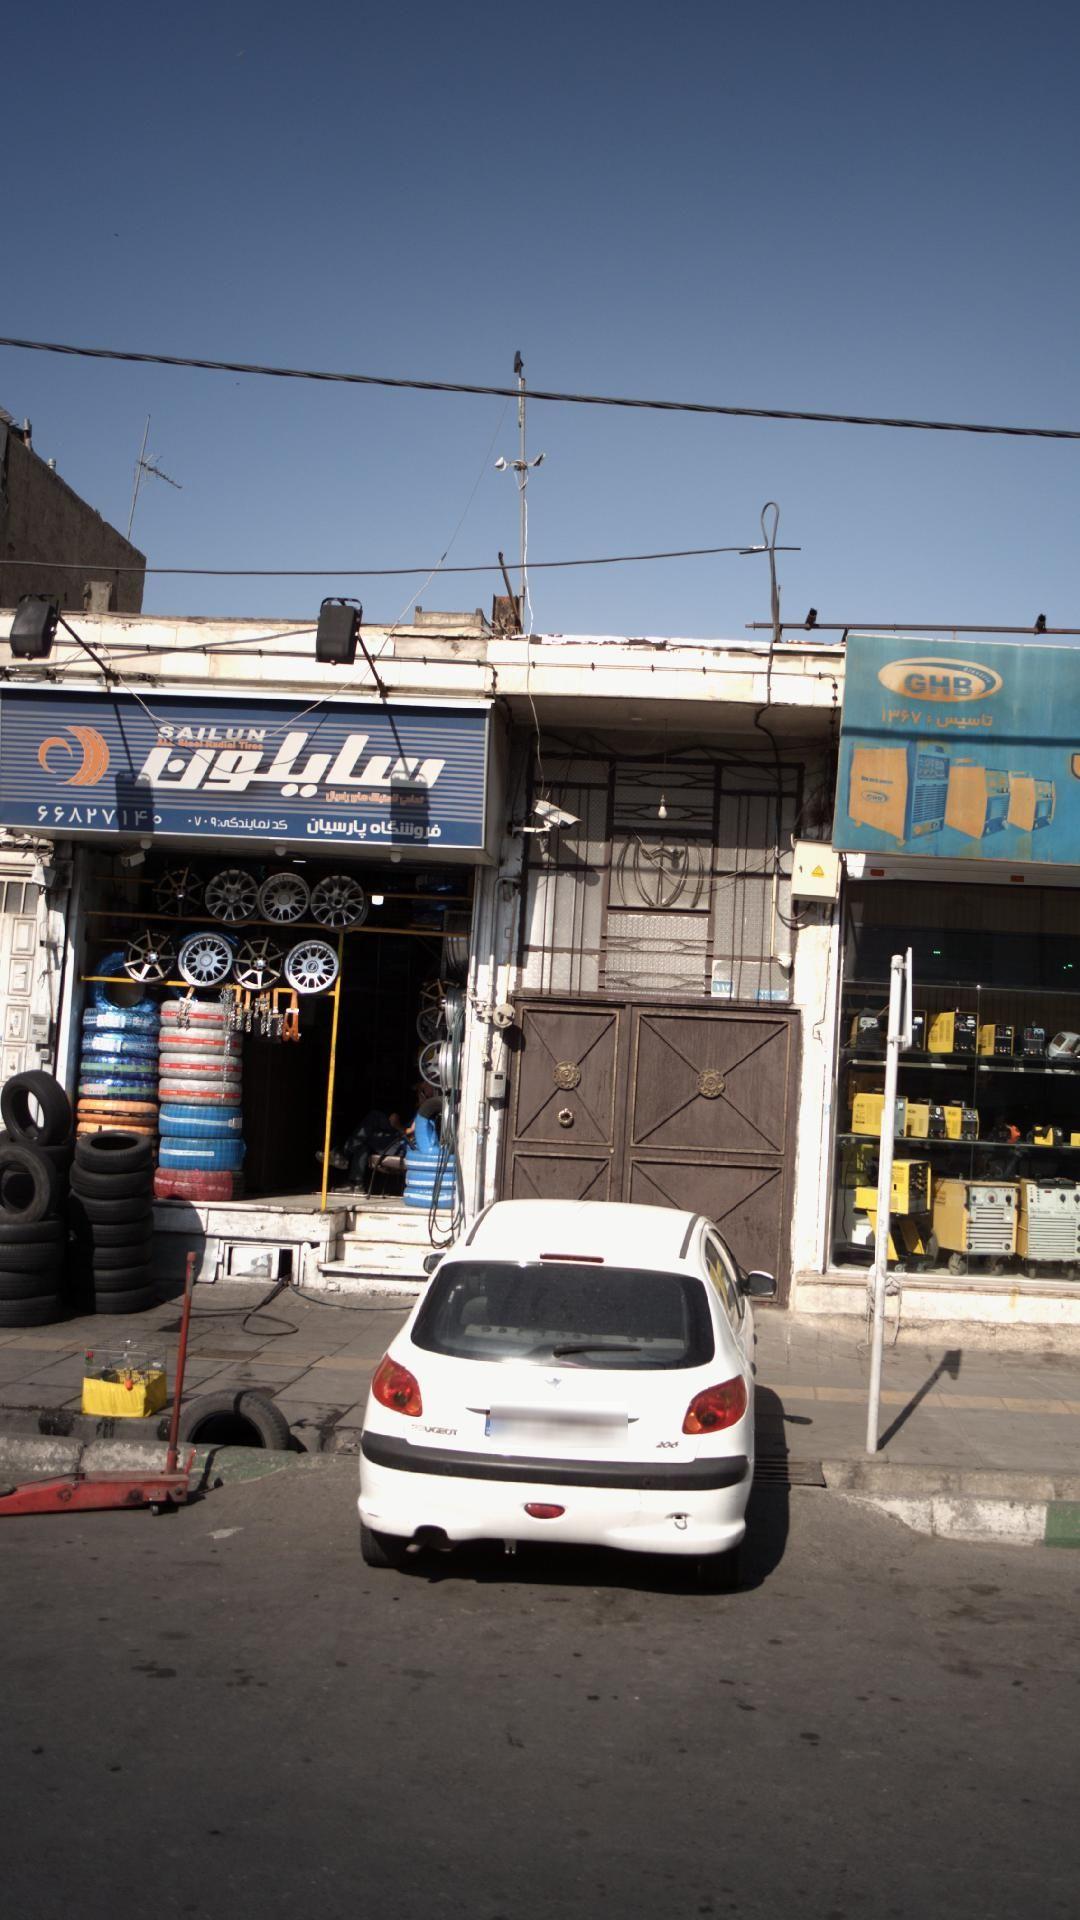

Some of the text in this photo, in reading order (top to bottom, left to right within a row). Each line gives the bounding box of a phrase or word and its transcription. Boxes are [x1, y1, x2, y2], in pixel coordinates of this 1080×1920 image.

[905, 674, 972, 696] GHB
[881, 704, 923, 725] ۱۳۶۷
[157, 726, 266, 742] SAILUN
[134, 731, 447, 798] سایلون
[272, 819, 289, 830] کد
[306, 817, 442, 839] فروشگاه پارسیان
